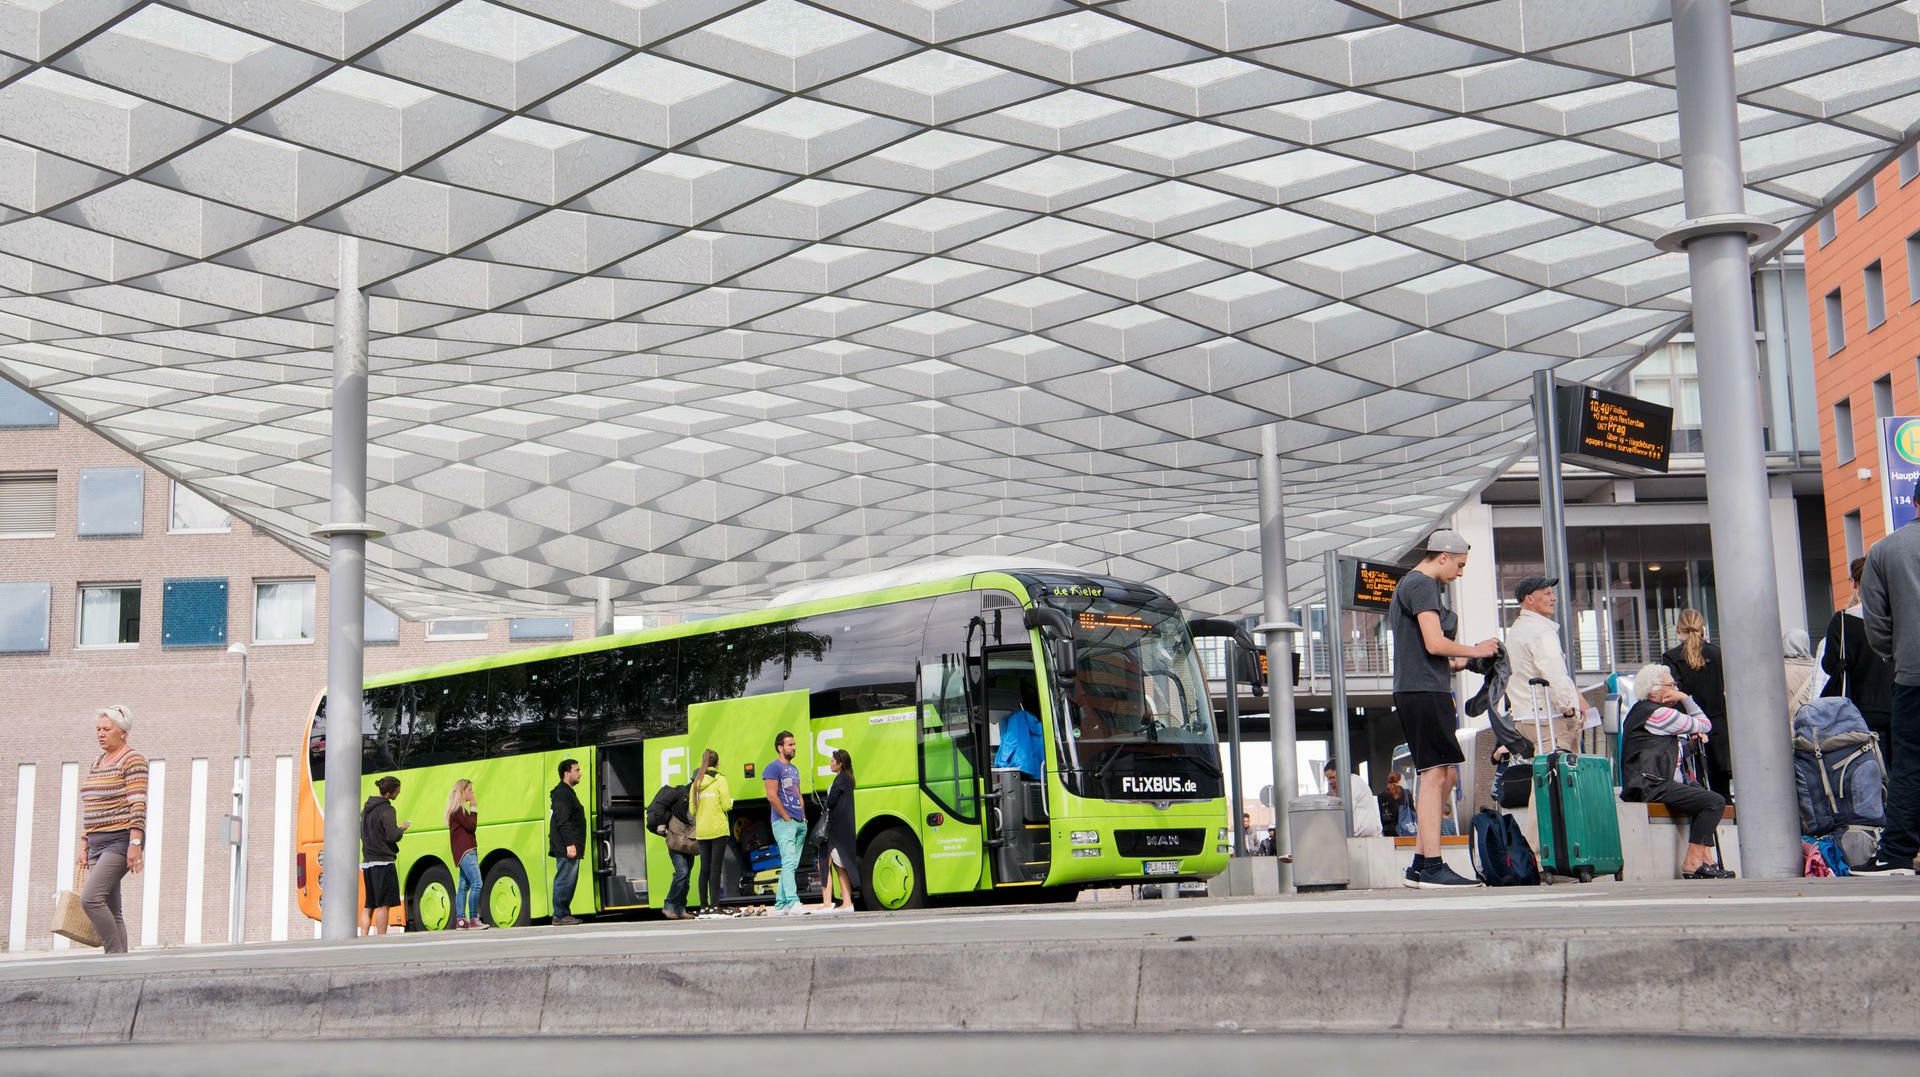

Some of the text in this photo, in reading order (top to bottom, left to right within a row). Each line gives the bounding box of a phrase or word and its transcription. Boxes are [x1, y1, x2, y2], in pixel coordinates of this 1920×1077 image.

[1590, 400, 1610, 415] 10:40
[1608, 421, 1626, 436] Prag
[1894, 495, 1911, 505] 134
[1053, 584, 1102, 597] de Kieler
[1146, 835, 1179, 846] MAN
